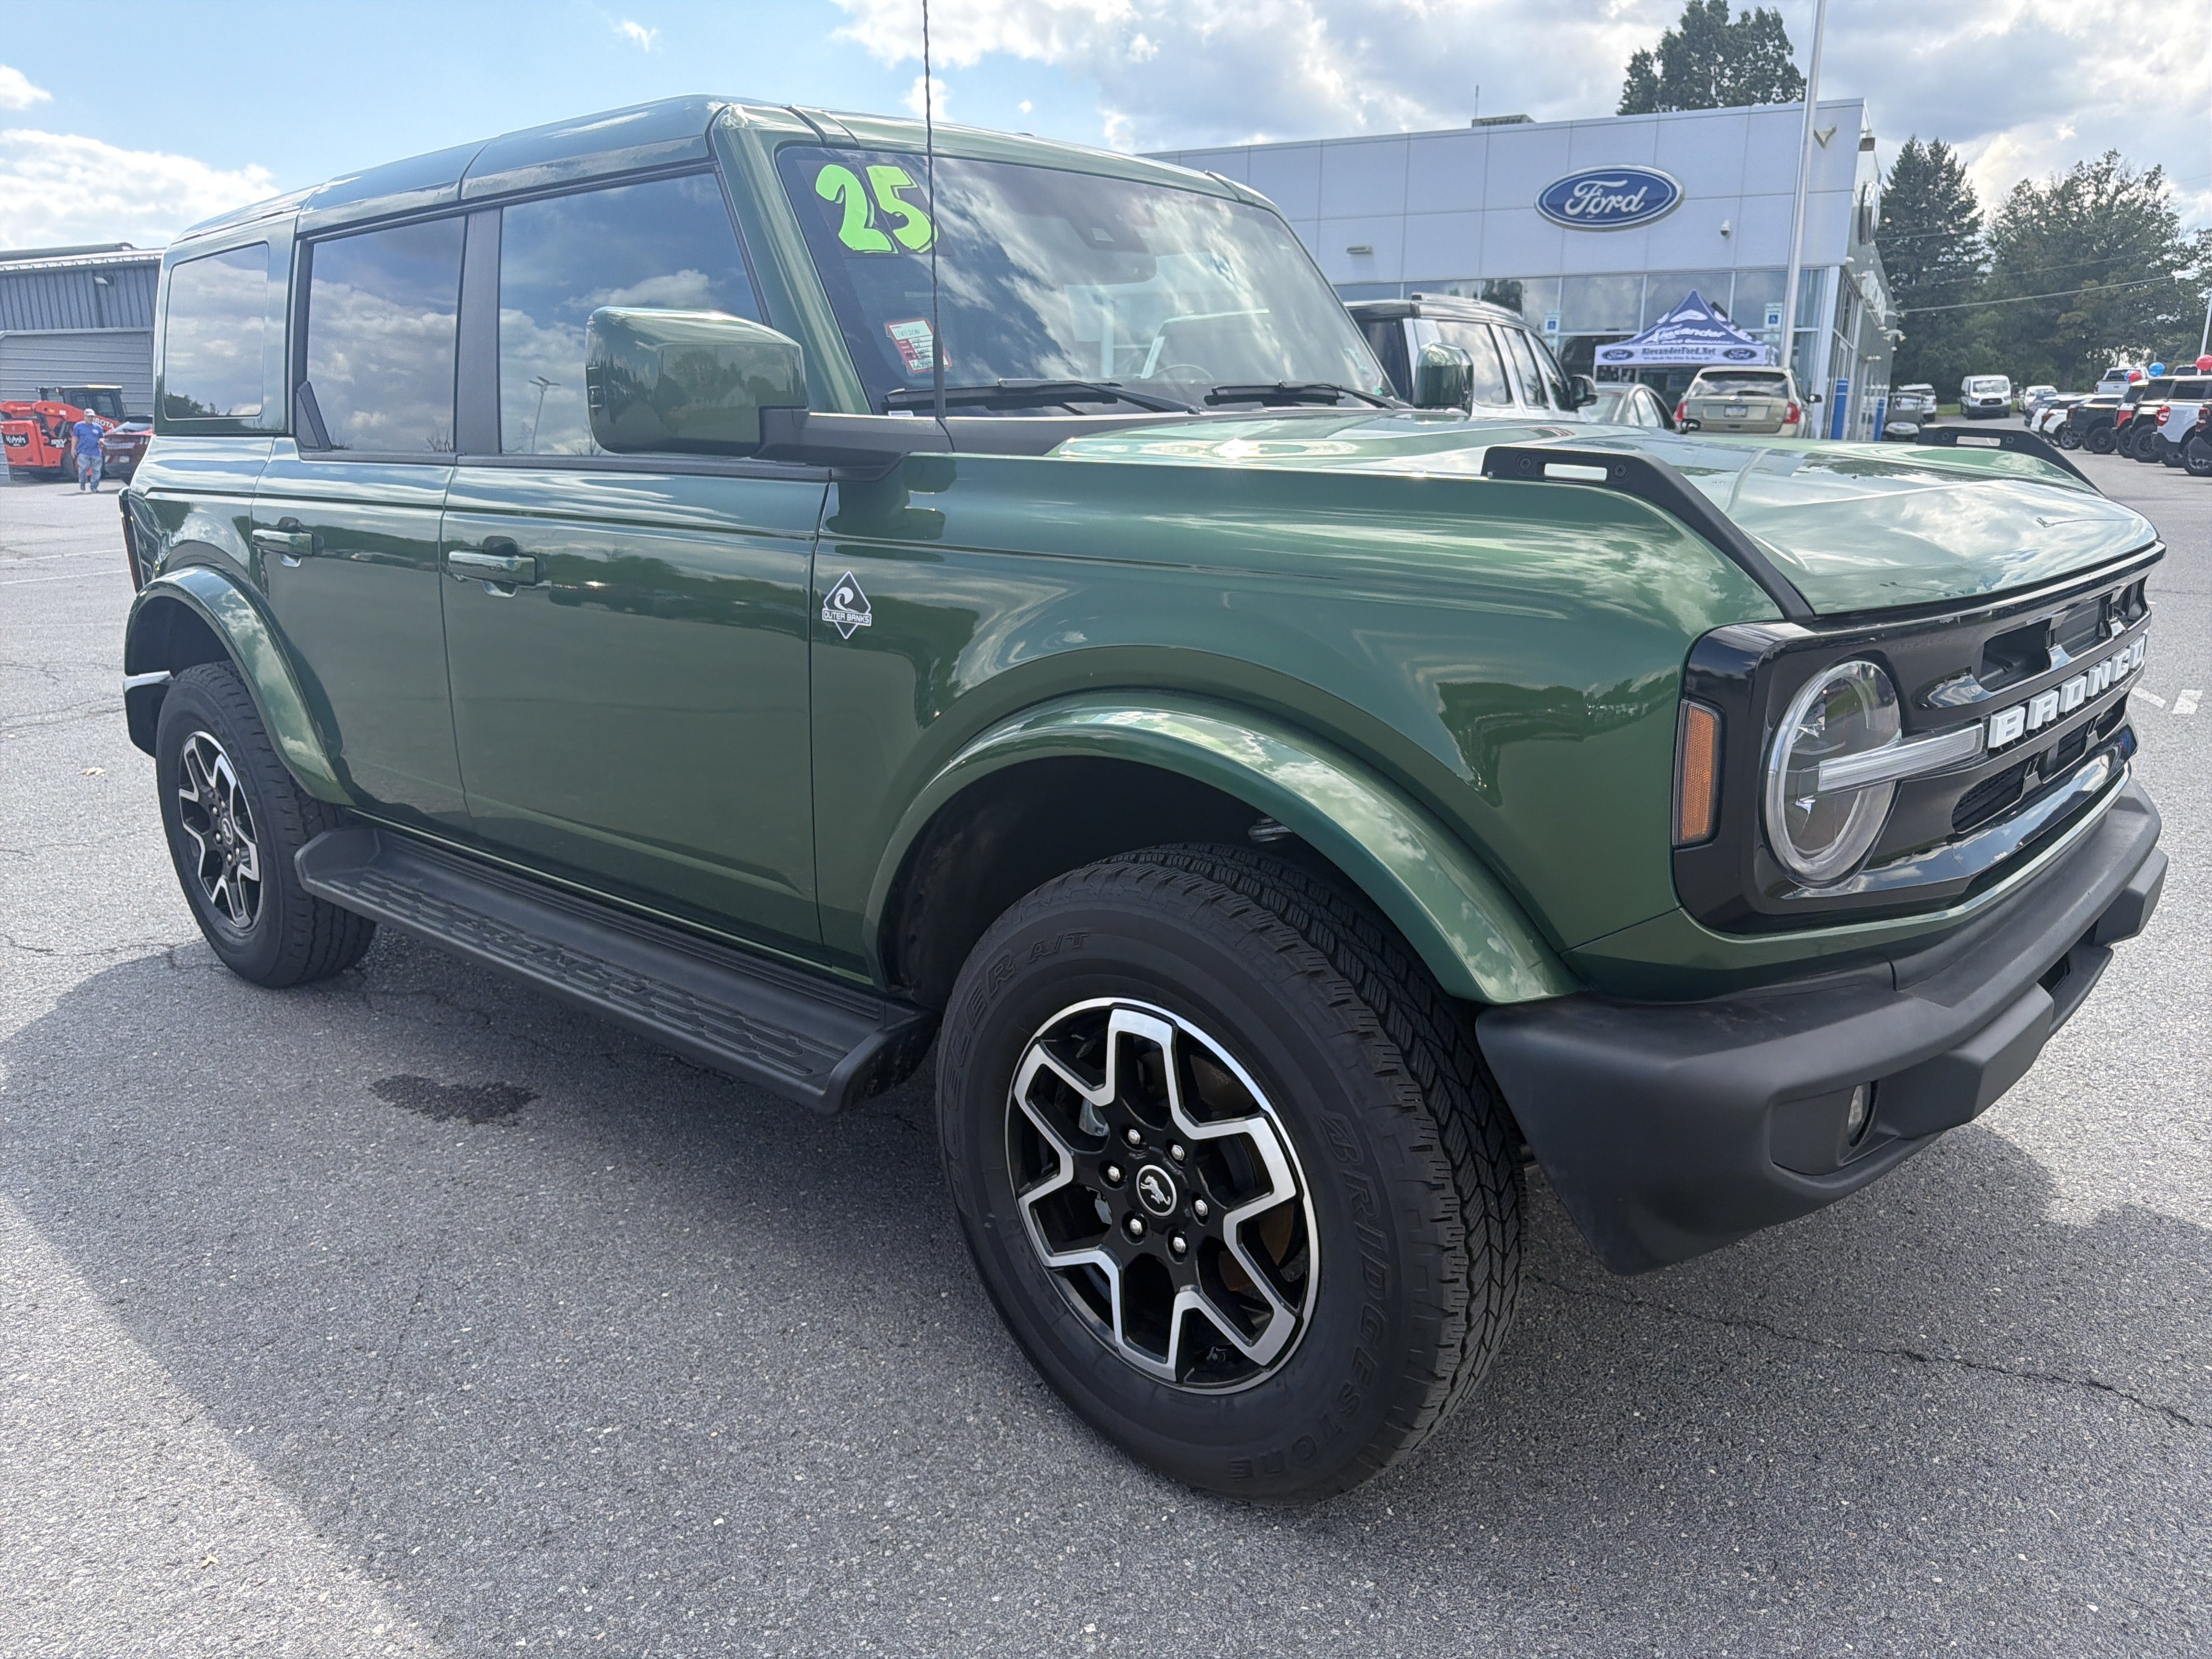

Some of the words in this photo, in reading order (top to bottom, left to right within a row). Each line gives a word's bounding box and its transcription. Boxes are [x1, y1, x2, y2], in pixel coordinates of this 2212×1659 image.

[815, 164, 939, 253] 25
[1565, 179, 1648, 219] Ford
[824, 611, 845, 620] OUTER
[847, 613, 870, 623] BANKS
[1988, 634, 2146, 749] BRONCO
[1028, 928, 1091, 963] A/T
[1227, 1111, 1391, 1481] BRIDGESTONE
